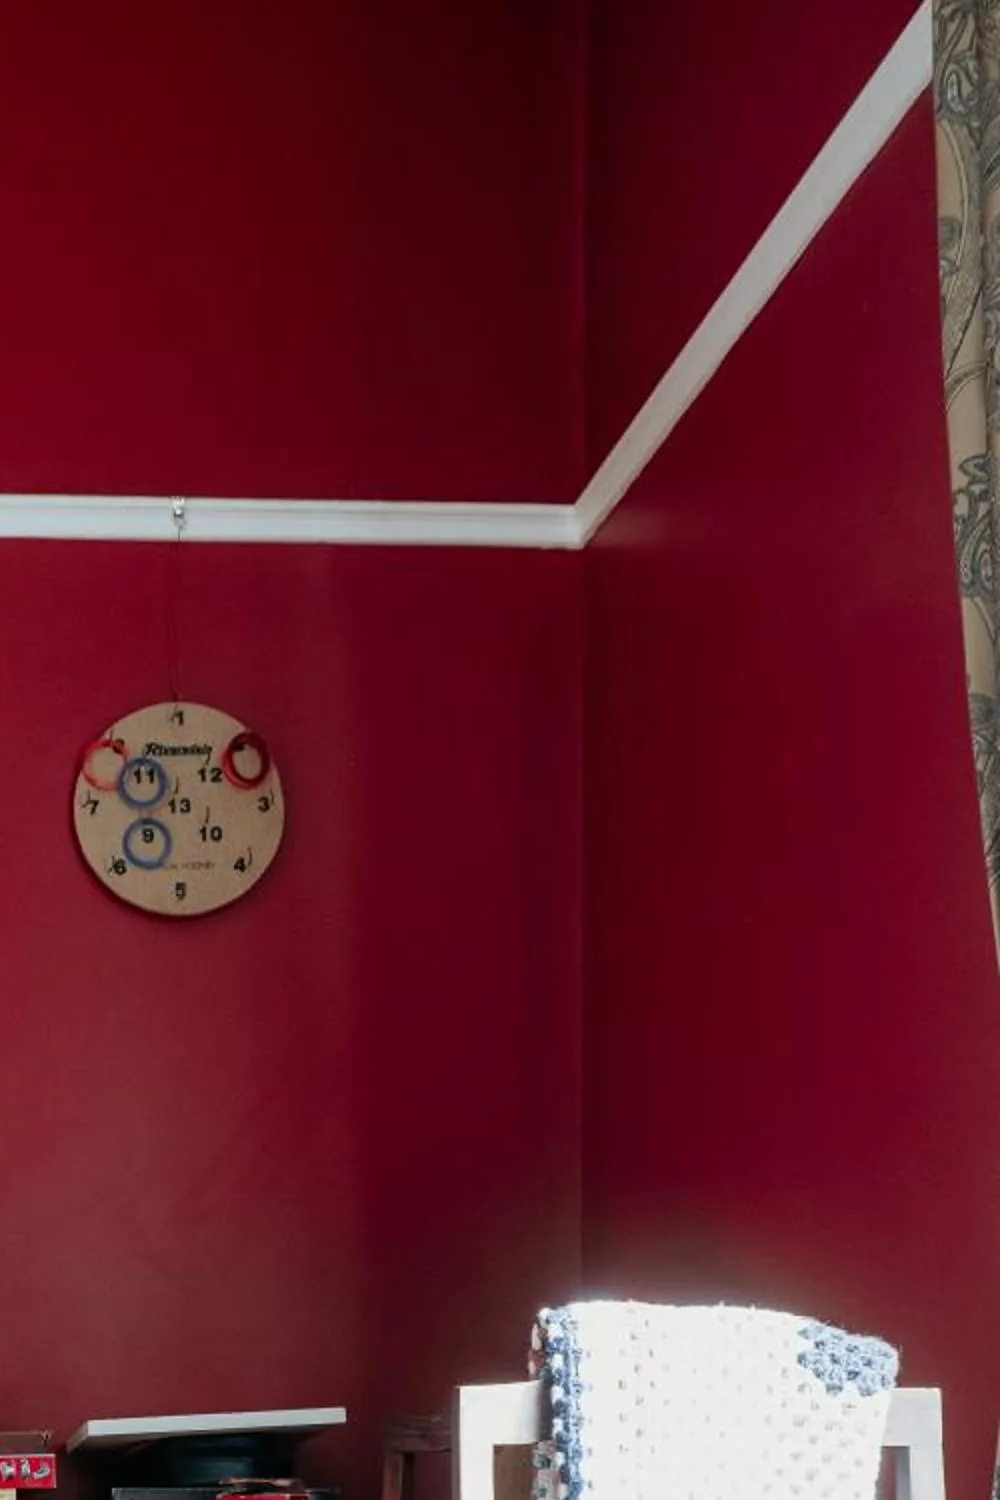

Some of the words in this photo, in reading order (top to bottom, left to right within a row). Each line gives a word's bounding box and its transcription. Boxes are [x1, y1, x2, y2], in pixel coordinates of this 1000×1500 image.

[133, 769, 155, 784] 11
[198, 768, 223, 783] 12
[168, 799, 191, 814] 13
[258, 797, 270, 812] 3
[142, 829, 154, 844] 9
[199, 827, 223, 842] 10
[112, 860, 126, 875] 6
[234, 857, 246, 873] 4
[175, 883, 186, 900] 5
